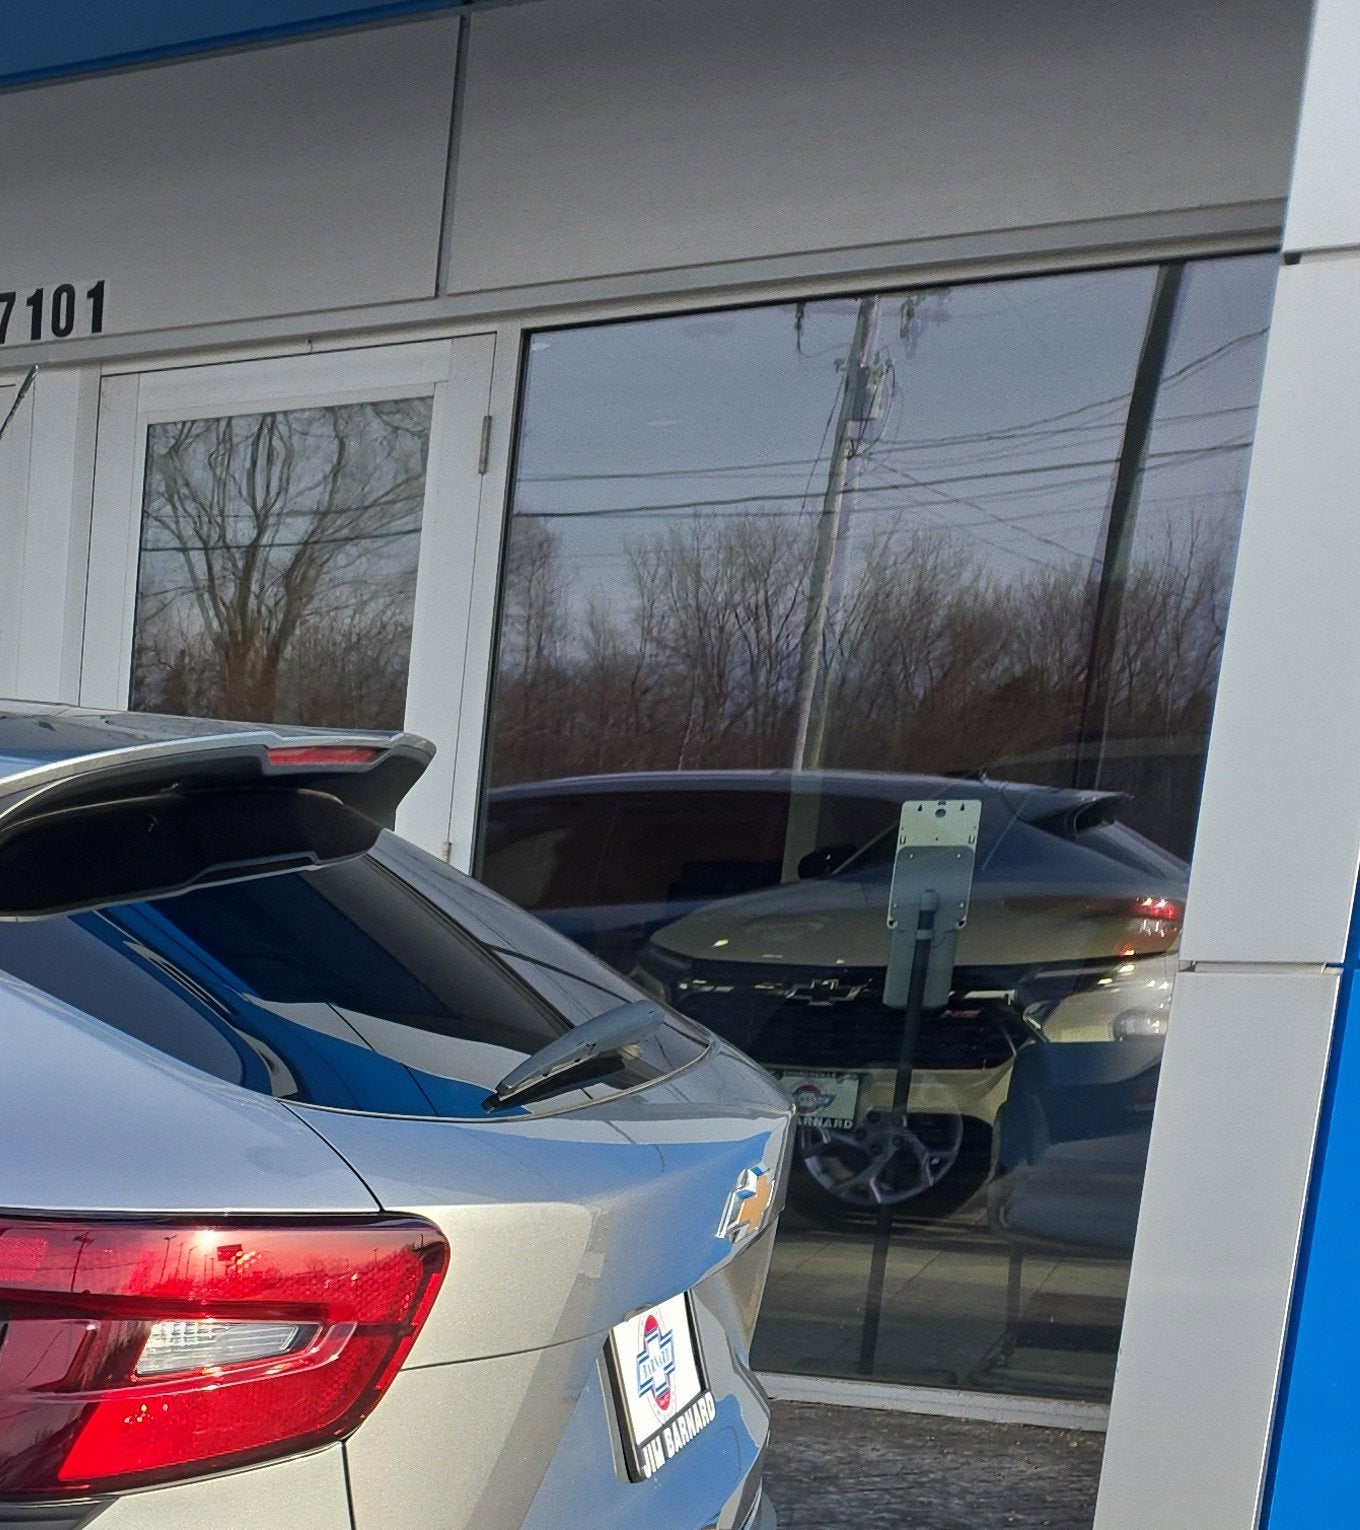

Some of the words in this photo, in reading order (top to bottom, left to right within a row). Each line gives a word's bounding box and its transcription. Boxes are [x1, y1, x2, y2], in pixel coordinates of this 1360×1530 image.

[641, 1347, 671, 1379] BARNARD
[640, 1436, 666, 1479] JIM
[664, 1391, 717, 1459] BARNARD
